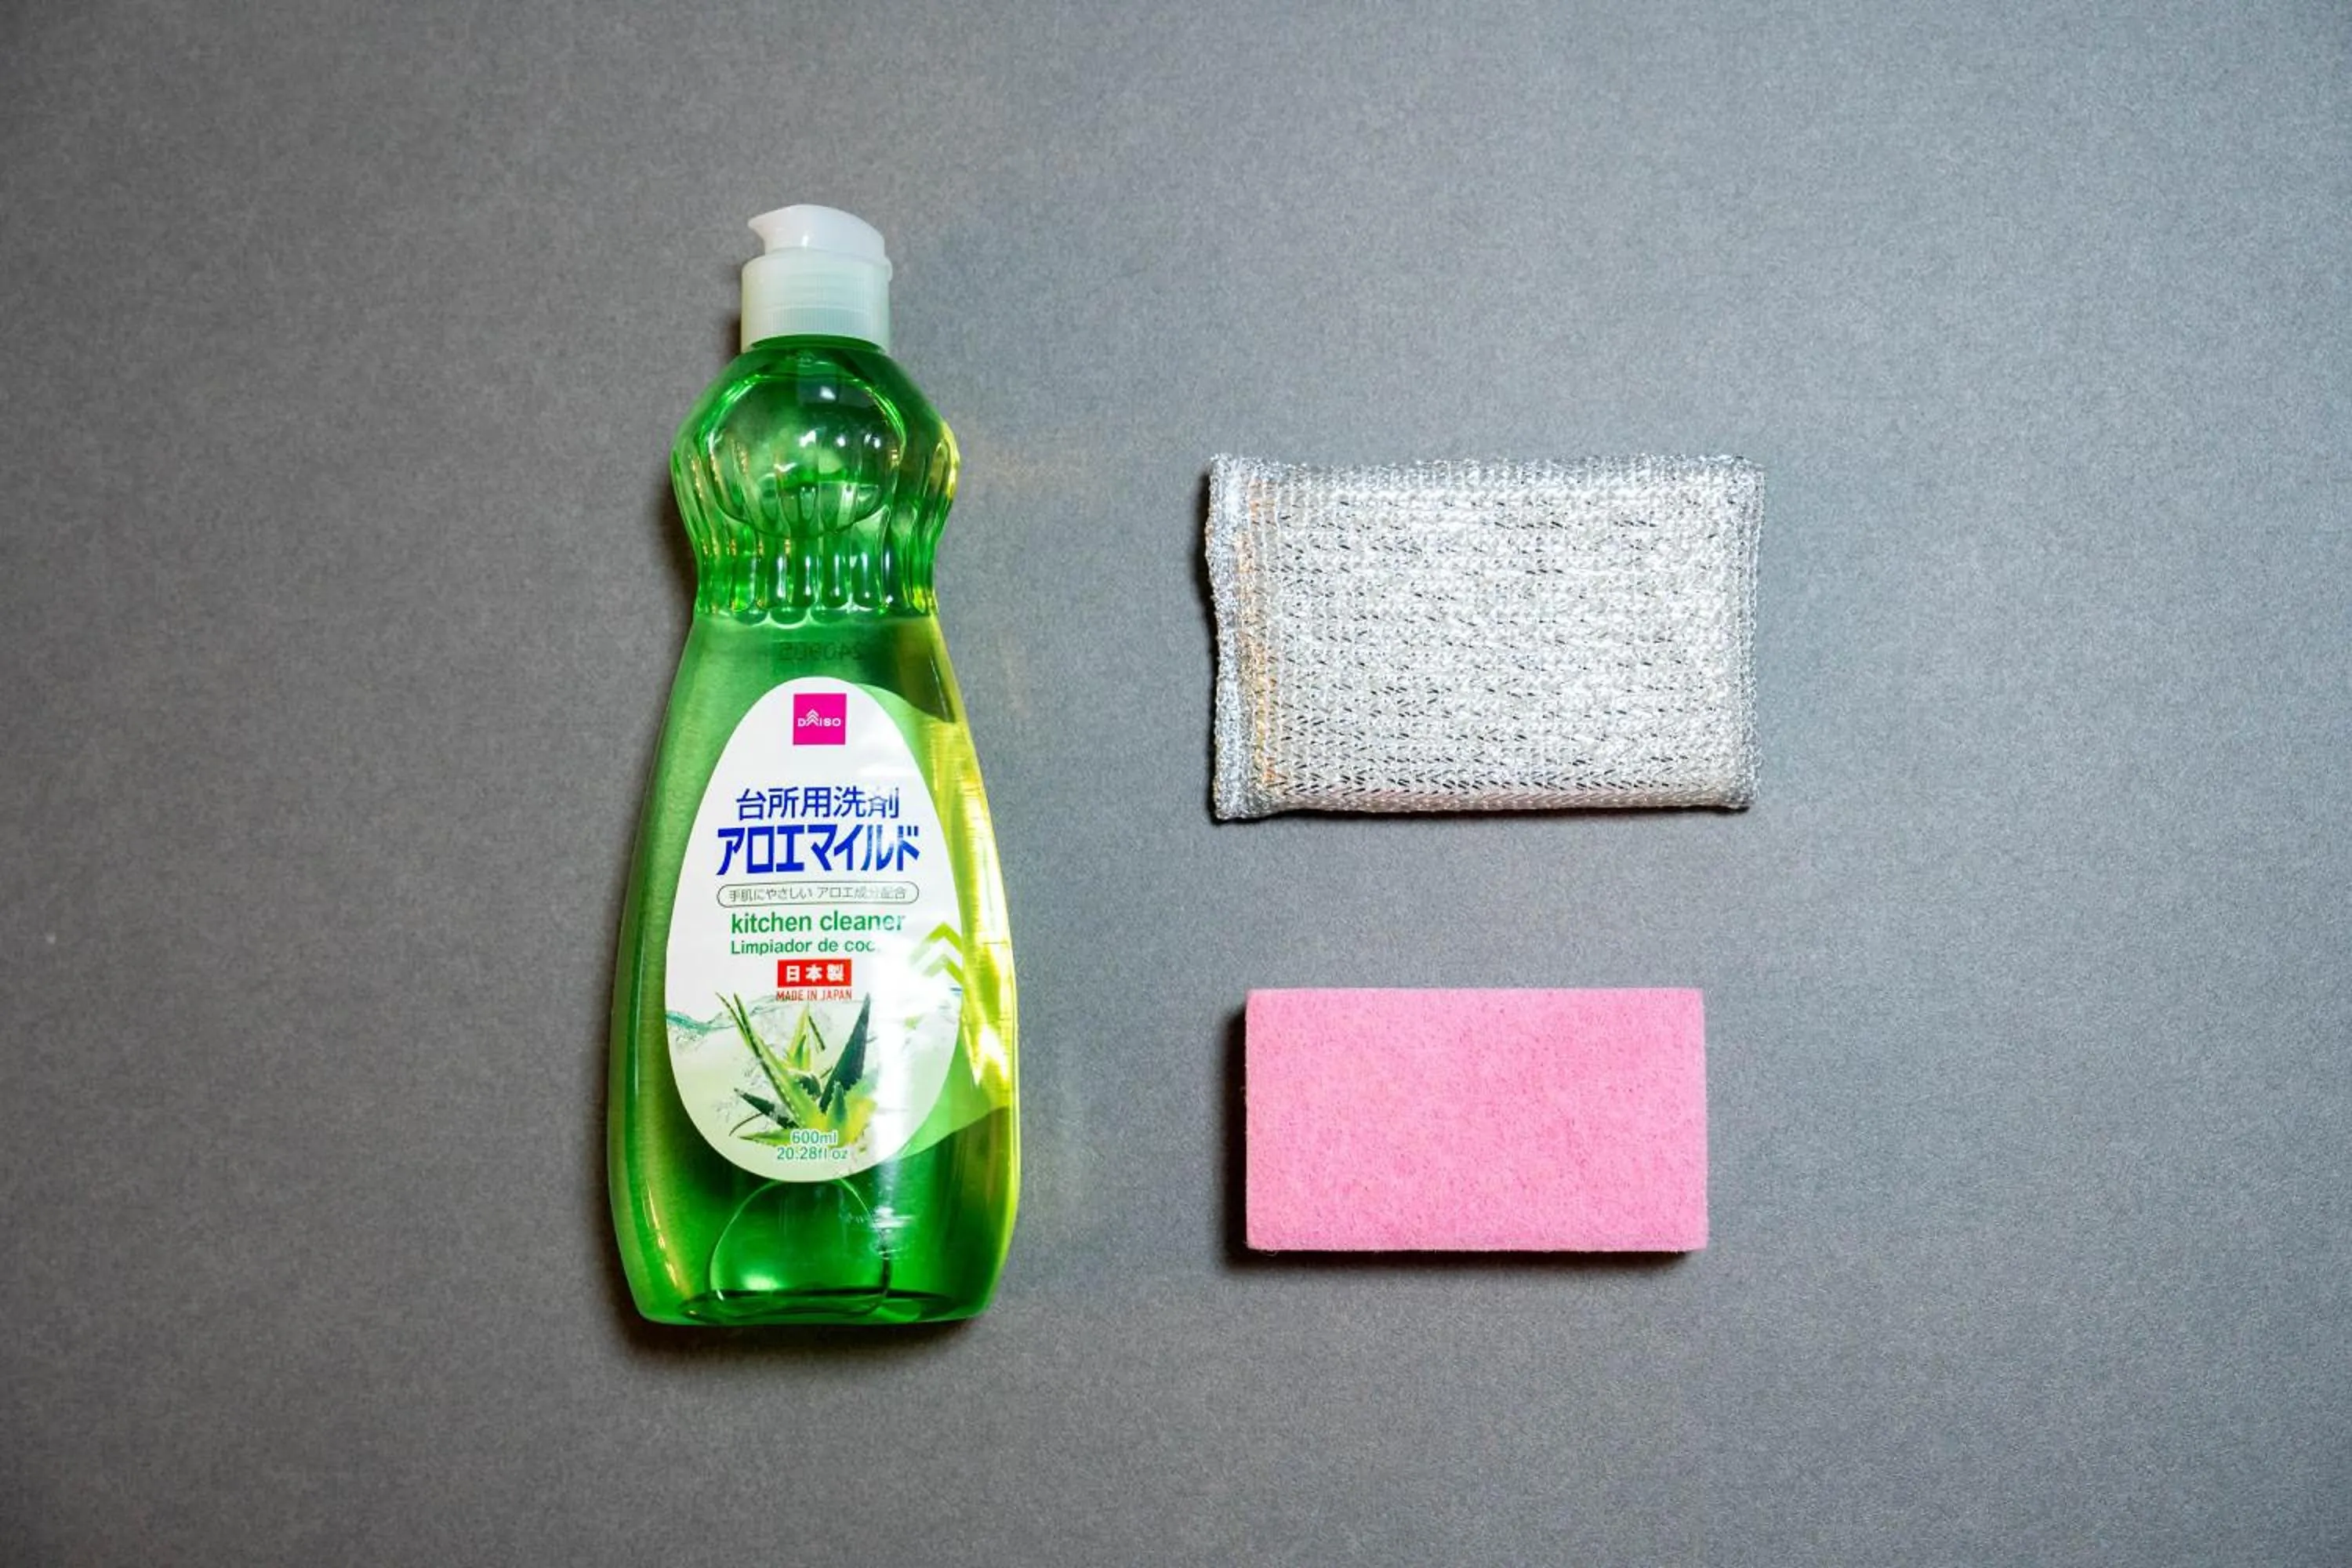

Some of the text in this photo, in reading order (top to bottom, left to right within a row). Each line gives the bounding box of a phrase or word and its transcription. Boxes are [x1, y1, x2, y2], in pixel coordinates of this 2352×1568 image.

[797, 709, 841, 727] DAISO
[736, 786, 899, 820] 台所用洗剤
[717, 824, 920, 875] アロエマイルド
[731, 910, 906, 935] kitchen cleaner
[731, 940, 812, 956] Limpiador
[818, 938, 839, 953] de
[786, 964, 844, 982] 日本製
[776, 989, 852, 1001] MADE IN JAPAN
[792, 1131, 837, 1145] 600ml
